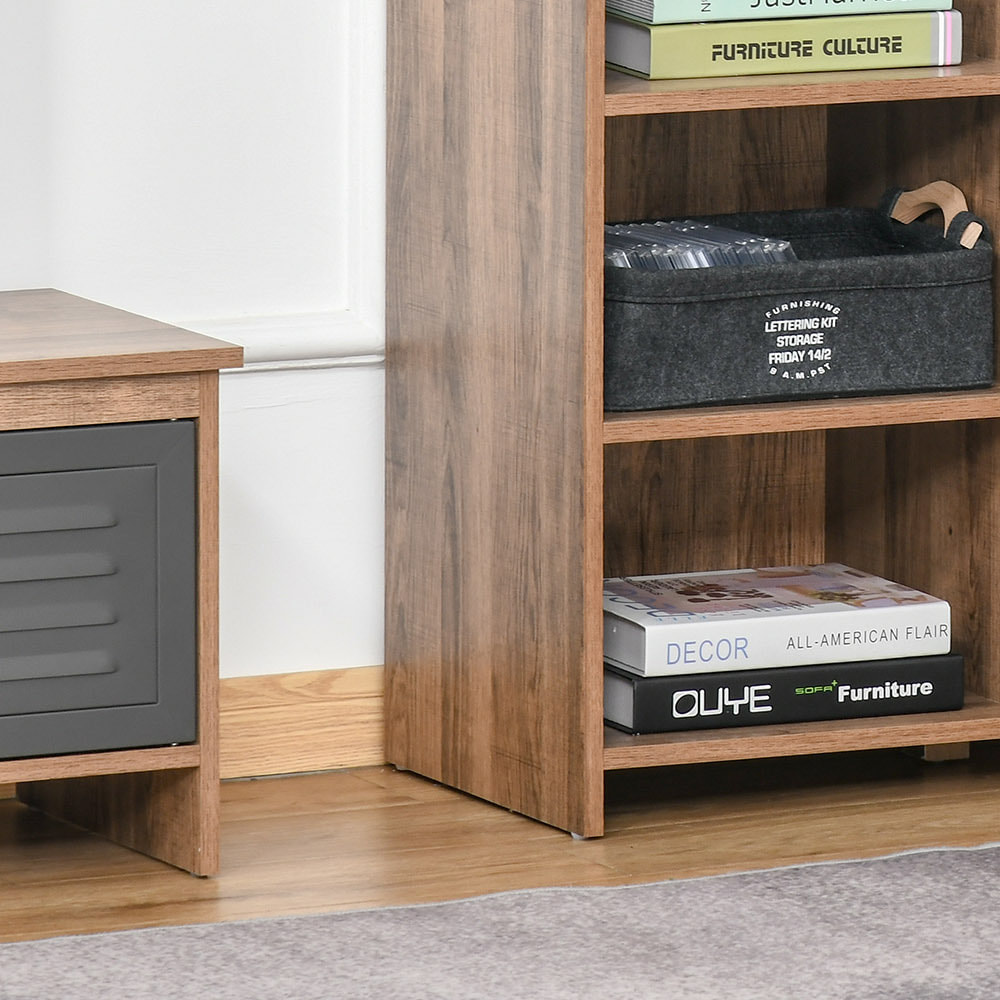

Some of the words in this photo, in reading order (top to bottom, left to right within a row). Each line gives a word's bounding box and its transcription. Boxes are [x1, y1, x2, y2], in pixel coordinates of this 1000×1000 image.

[822, 35, 903, 56] CULTURE
[765, 300, 841, 319] FURNISHING
[764, 317, 820, 333] LETTERING
[820, 316, 839, 329] KIT
[776, 332, 825, 348] STORAGE
[768, 350, 806, 365] FRIDAY
[807, 348, 832, 362] 14/2
[666, 636, 750, 666] DECOR
[786, 627, 900, 651] ALL-AMERICAN
[905, 623, 949, 640] FLAIR
[837, 681, 934, 703] Furniture
